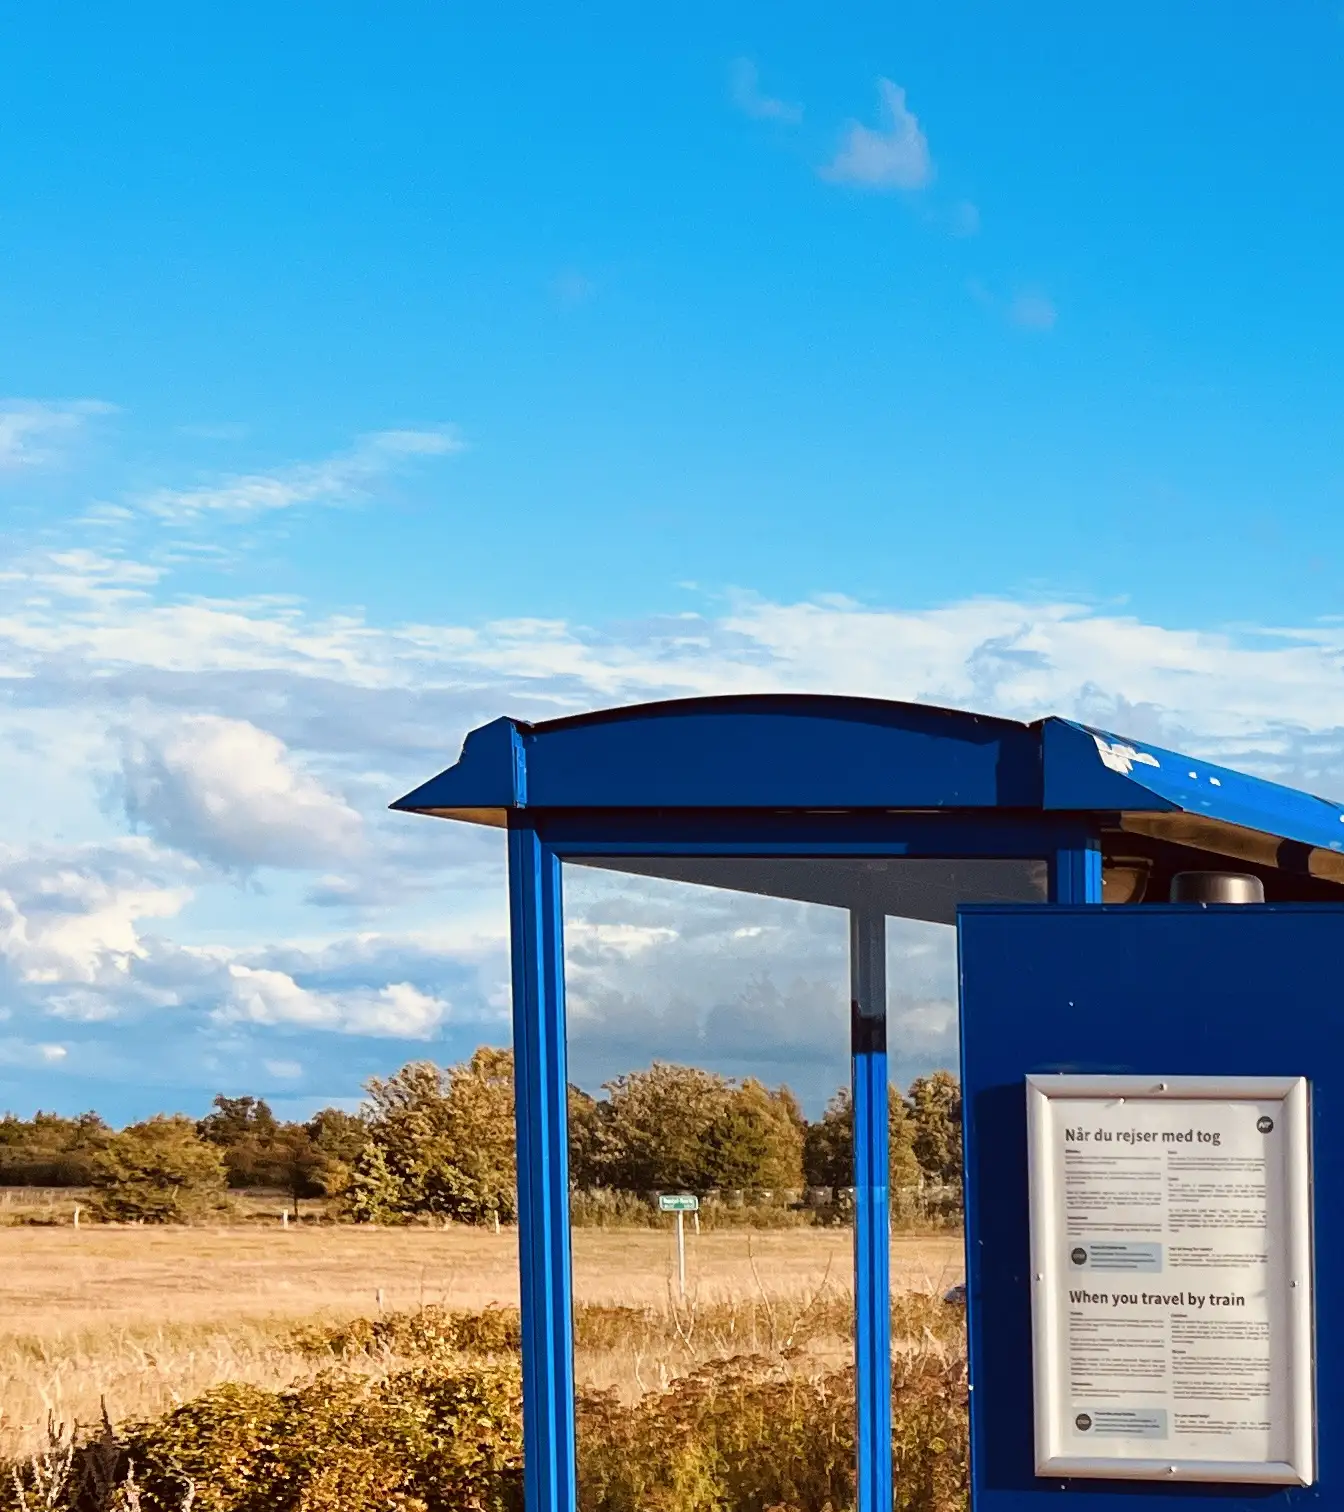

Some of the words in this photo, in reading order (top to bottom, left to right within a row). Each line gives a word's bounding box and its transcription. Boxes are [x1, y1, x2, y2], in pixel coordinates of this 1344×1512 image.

[1065, 1127, 1091, 1142] Når
[1094, 1128, 1113, 1142] du
[1116, 1129, 1159, 1146] rejser
[1162, 1130, 1193, 1143] med
[1197, 1131, 1221, 1146] tog
[1069, 1290, 1109, 1305] When
[1112, 1294, 1138, 1307] you
[1142, 1292, 1184, 1306] travel
[1188, 1292, 1205, 1309] by
[1209, 1293, 1246, 1307] train
